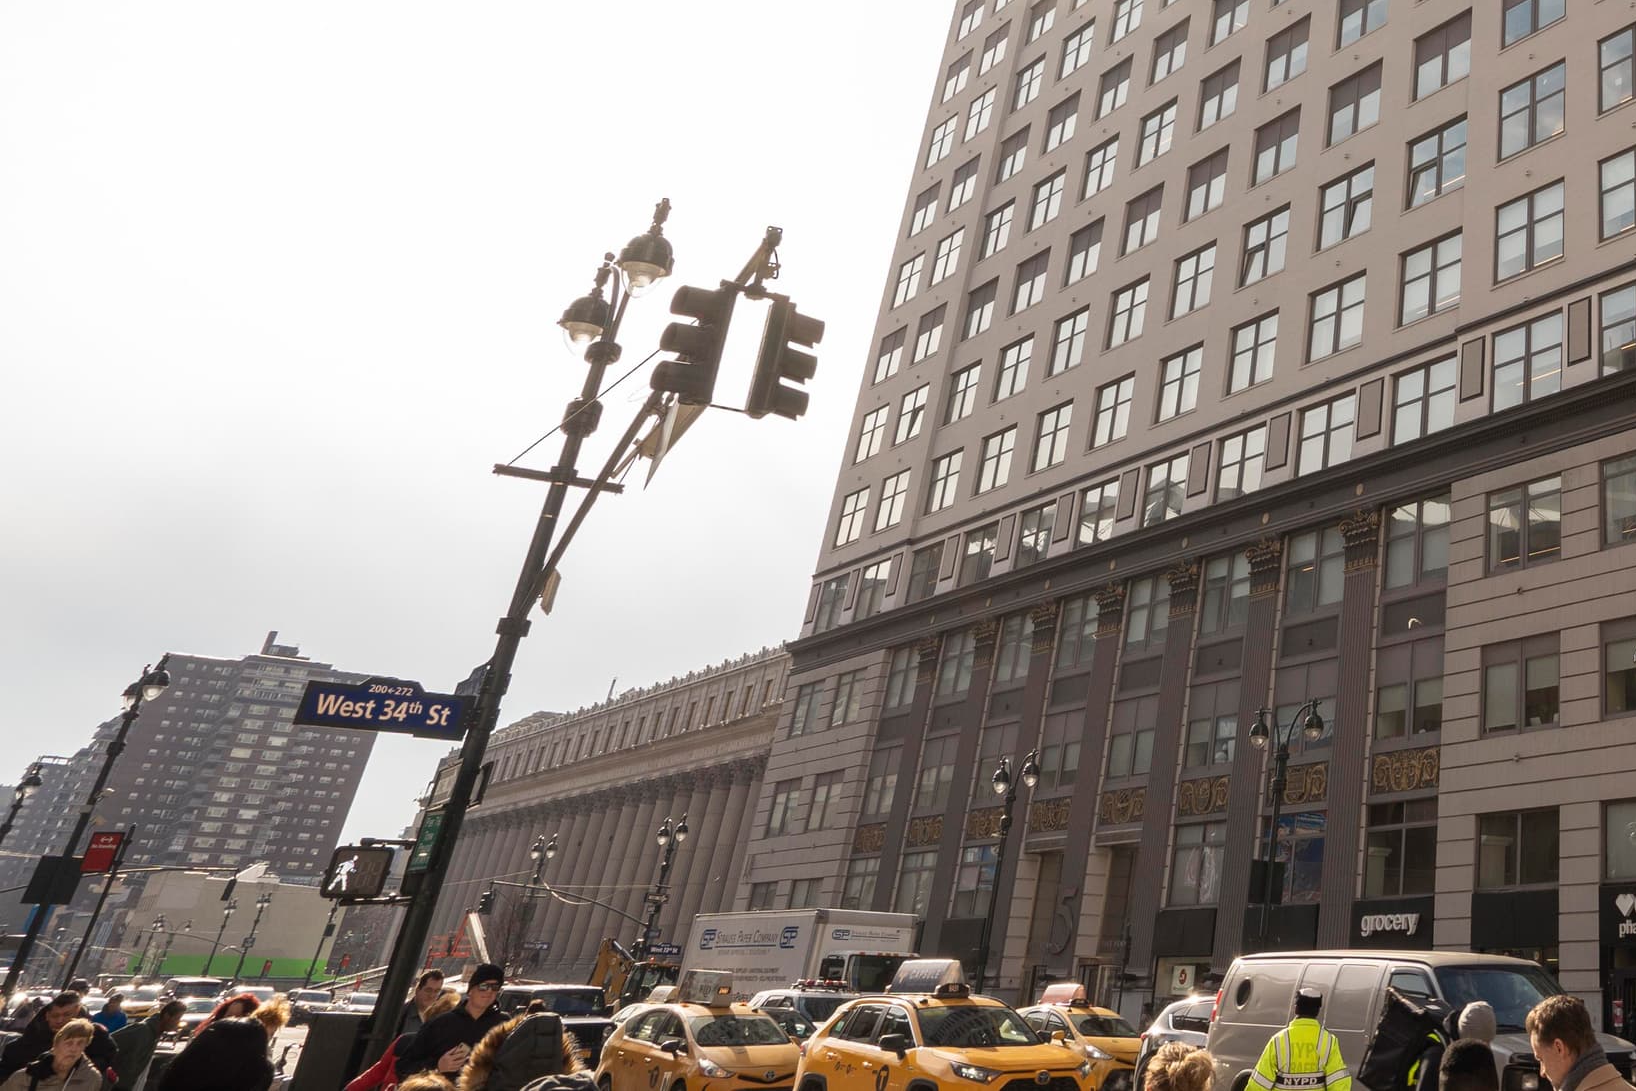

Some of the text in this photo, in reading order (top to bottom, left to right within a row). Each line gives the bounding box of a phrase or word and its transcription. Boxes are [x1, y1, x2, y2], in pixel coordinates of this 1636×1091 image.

[368, 684, 414, 697] 200 272
[316, 693, 452, 726] West 34th St
[1360, 912, 1420, 937] grocery
[753, 929, 779, 943] COMPANY
[1283, 1077, 1318, 1086] NYPD
